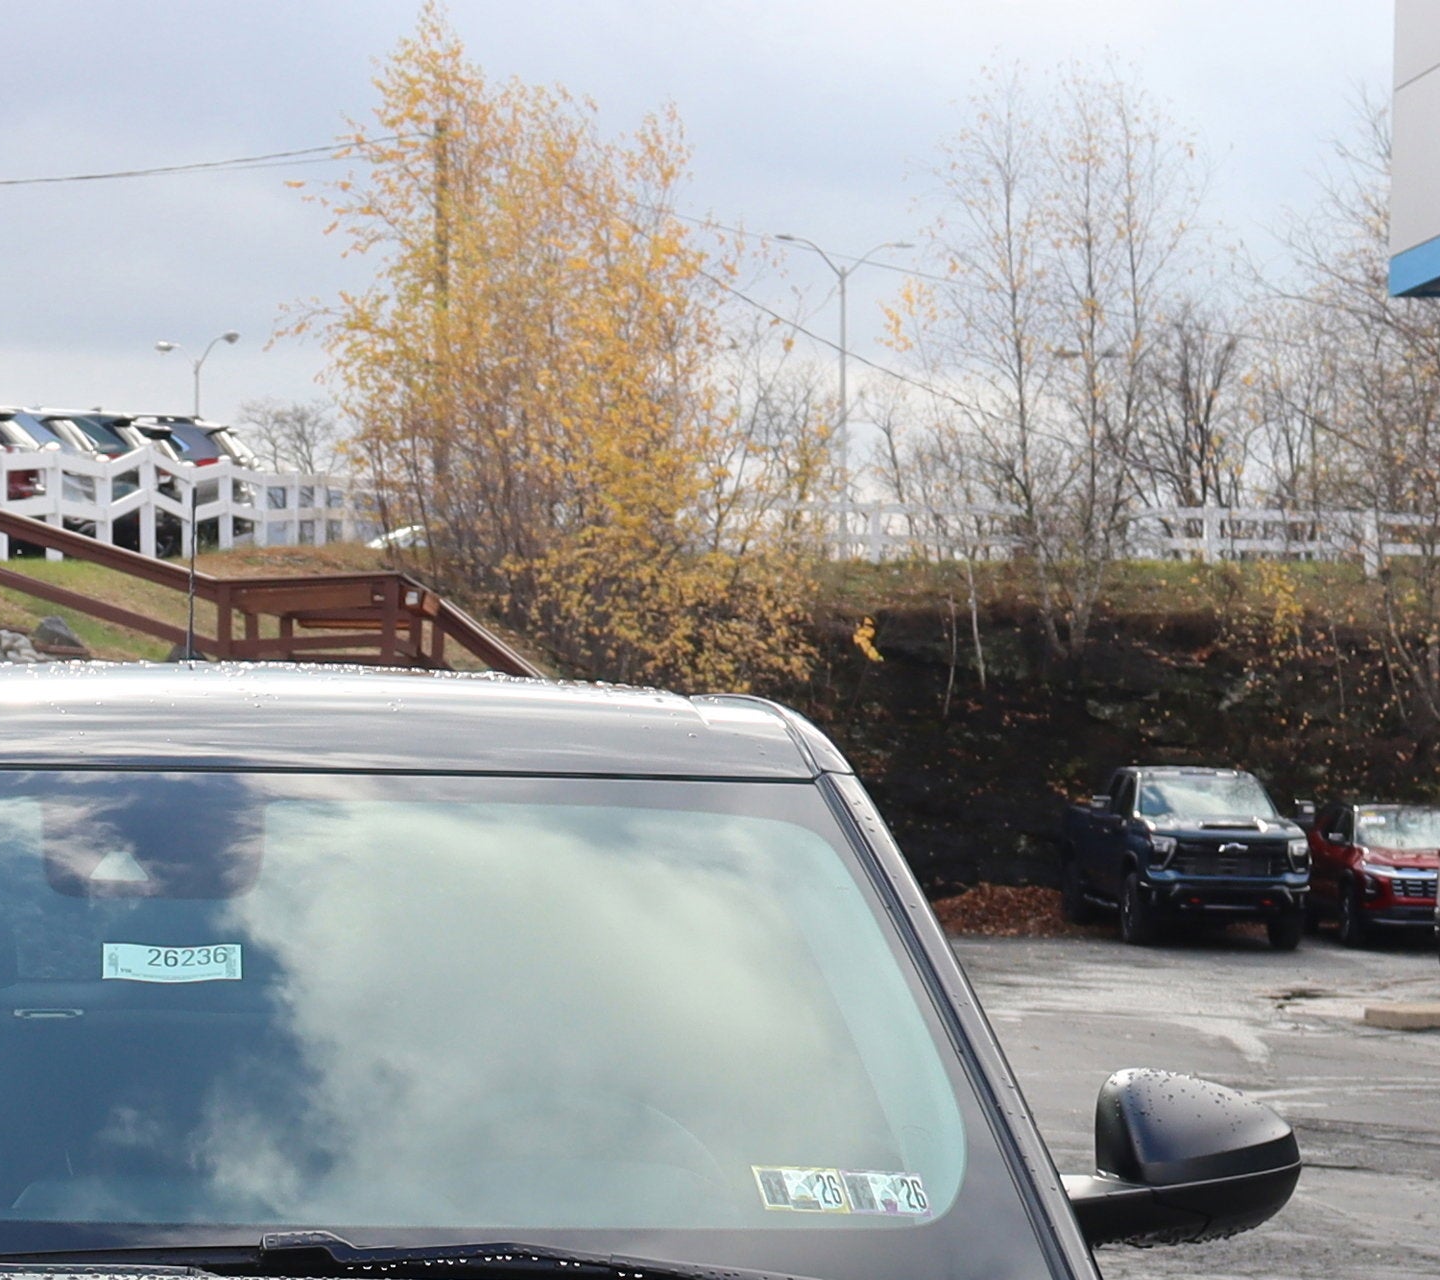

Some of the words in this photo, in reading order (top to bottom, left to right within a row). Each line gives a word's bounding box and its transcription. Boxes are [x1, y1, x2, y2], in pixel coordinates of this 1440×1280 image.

[147, 946, 228, 967] 26236
[815, 1174, 843, 1205] 26
[900, 1178, 928, 1210] 26
